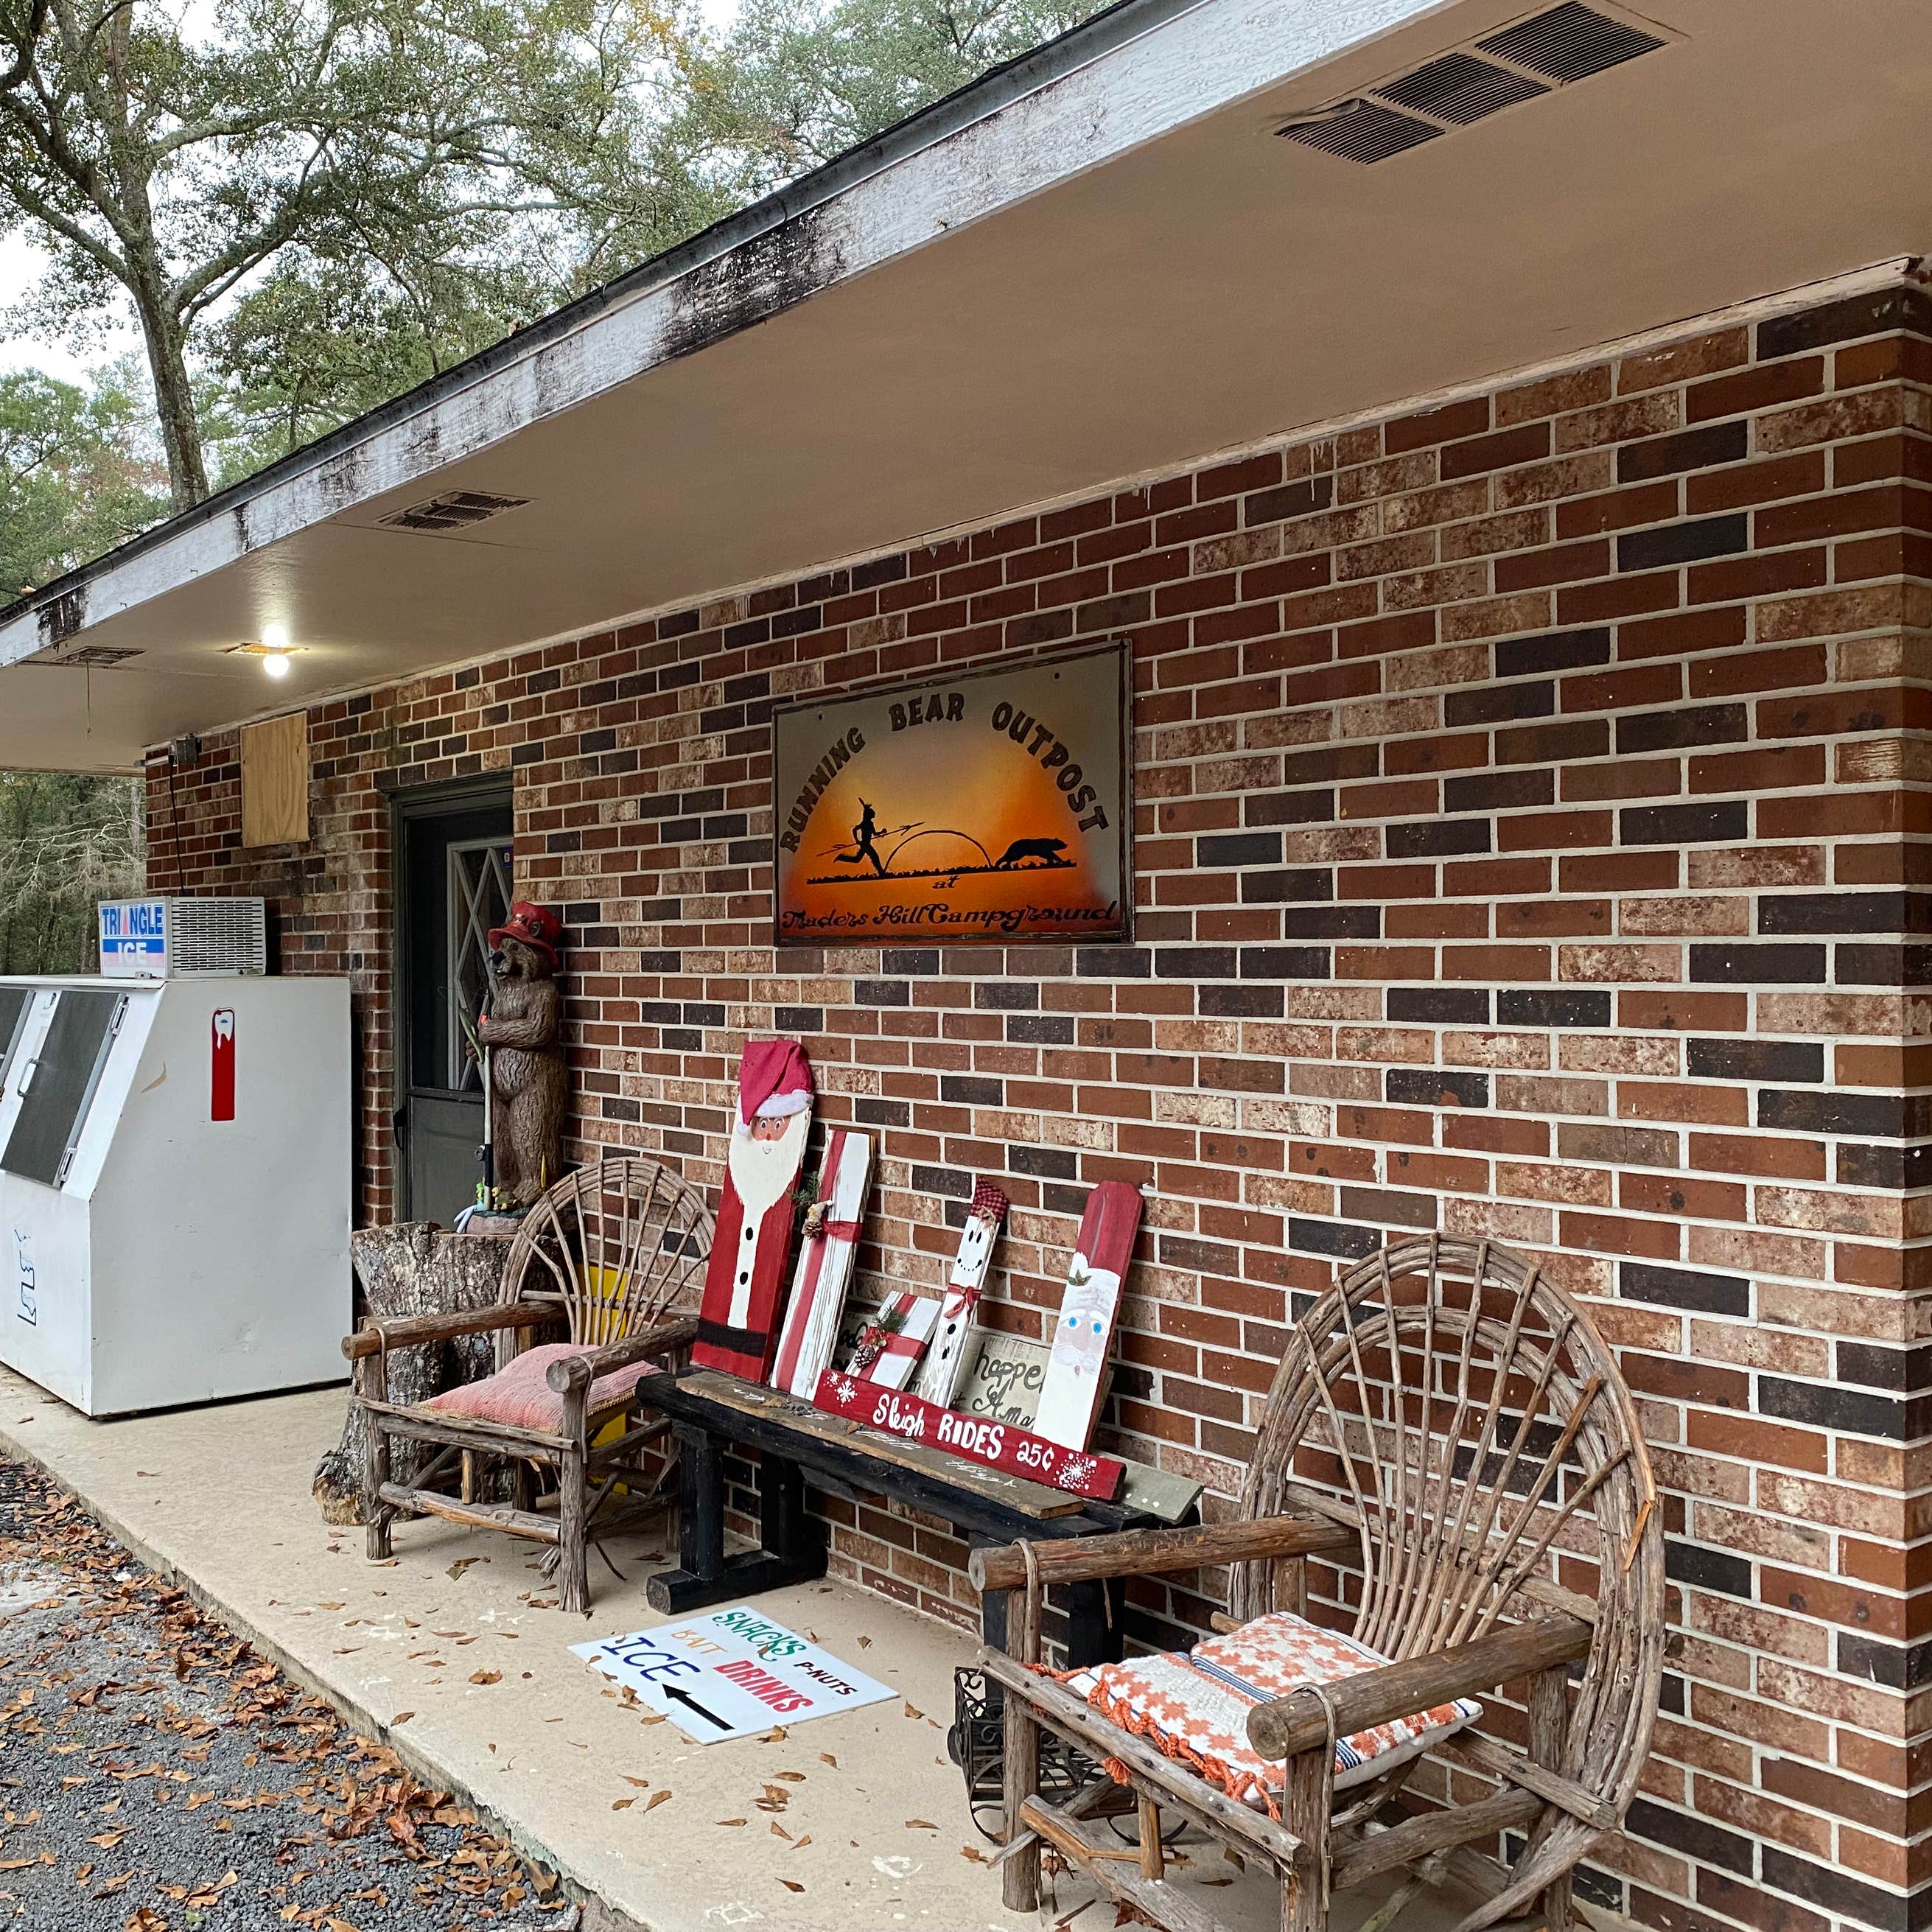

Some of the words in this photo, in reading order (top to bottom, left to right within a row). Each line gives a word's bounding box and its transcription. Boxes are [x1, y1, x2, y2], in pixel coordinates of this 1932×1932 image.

[780, 727, 866, 853] RUNNING
[889, 692, 965, 732] BEAR
[992, 701, 1109, 833] OUTPOST
[931, 875, 960, 889] at
[872, 904, 924, 925] Hill
[925, 901, 1118, 931] Campground
[117, 942, 147, 964] ICE
[872, 1394, 925, 1438] Sleigh
[937, 1413, 1005, 1460] RIDES
[1016, 1441, 1055, 1472] 25¢
[671, 1628, 729, 1655] BAIT
[712, 1611, 808, 1662] SNACKS
[600, 1637, 701, 1682] ICE
[713, 1659, 814, 1713] DRINKS
[794, 1662, 859, 1696] P-NUTS
